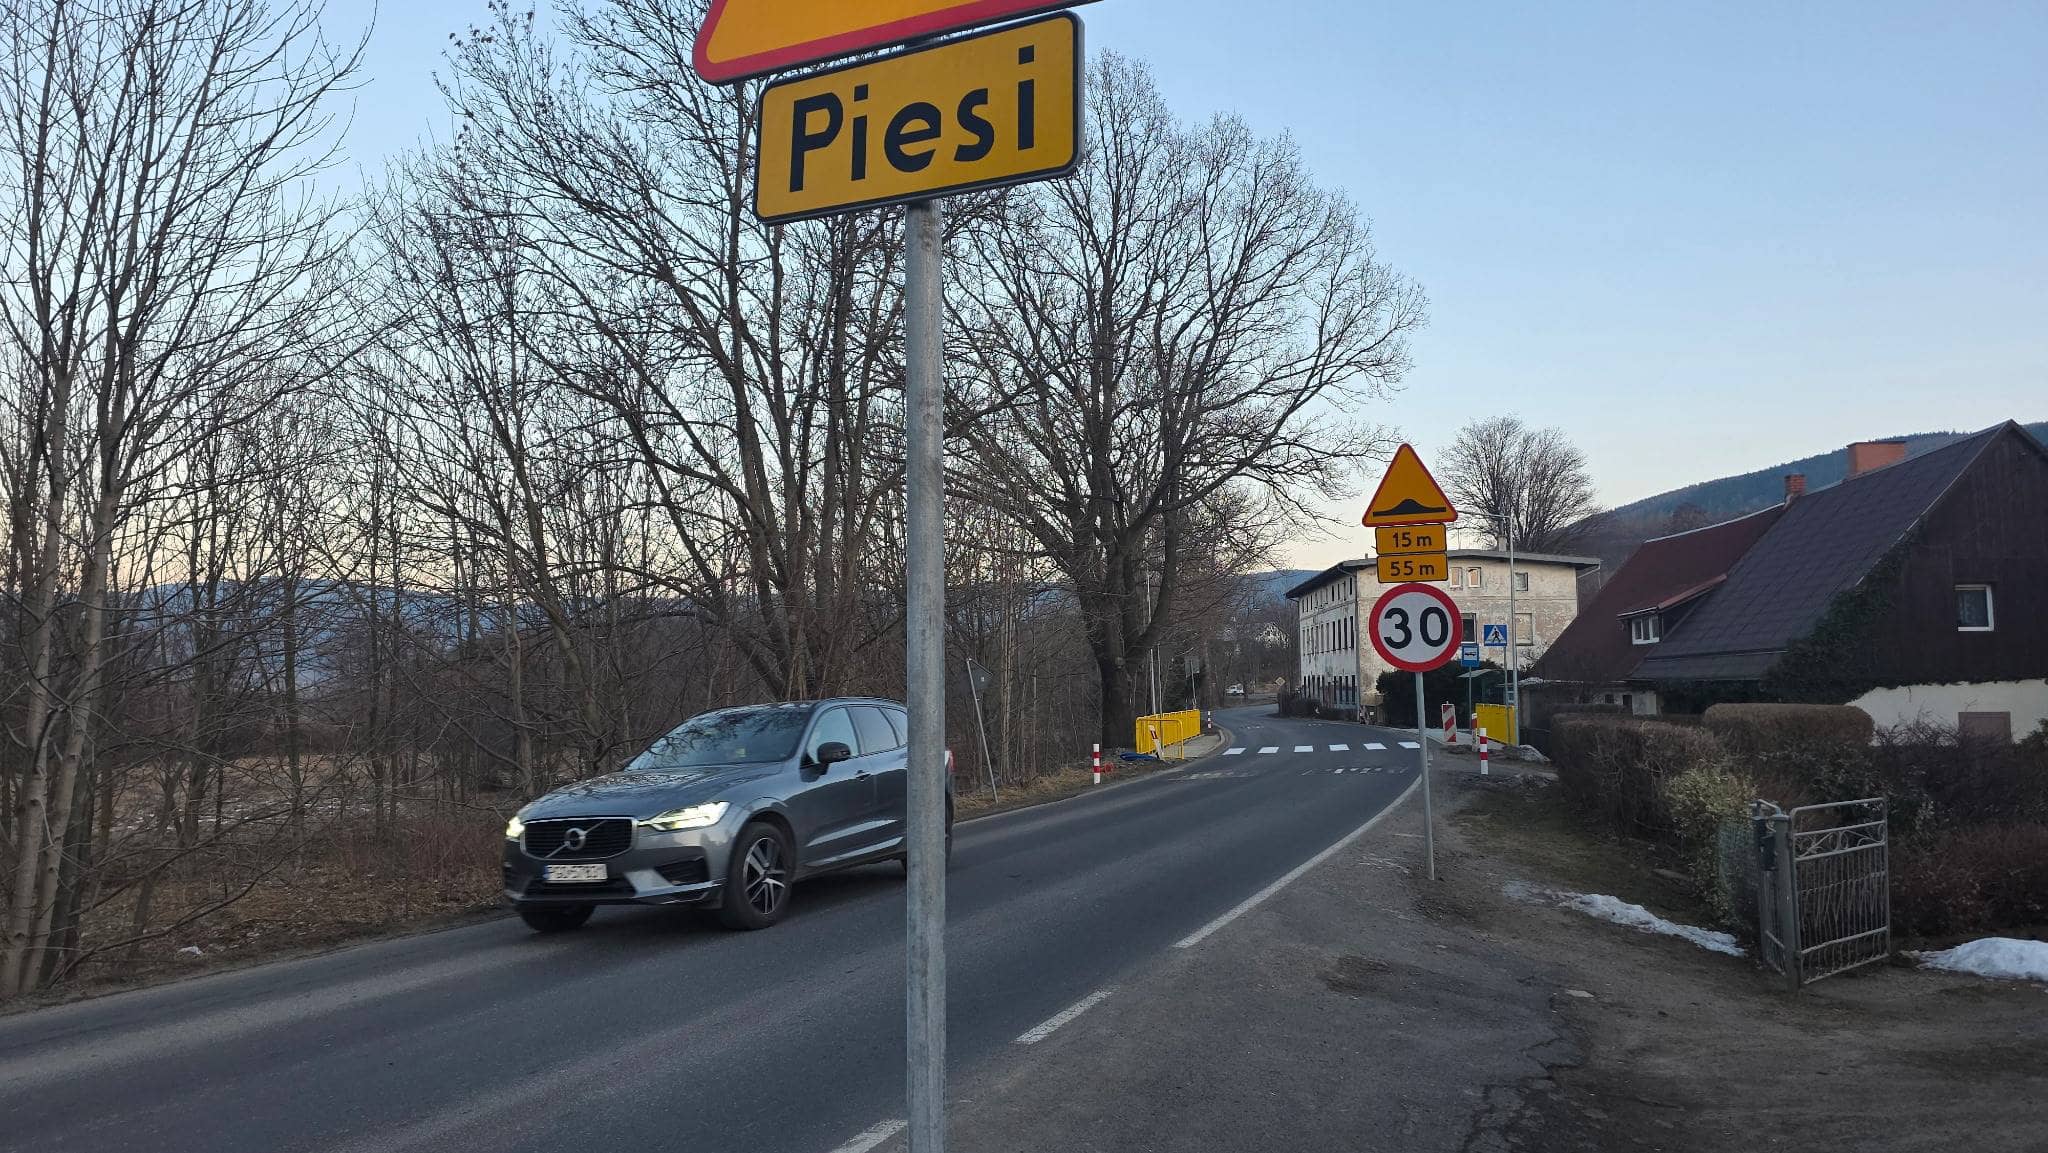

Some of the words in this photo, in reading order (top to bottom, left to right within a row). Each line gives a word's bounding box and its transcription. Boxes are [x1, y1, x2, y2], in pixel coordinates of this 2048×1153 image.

[789, 44, 1035, 193] Piesi
[1392, 532, 1412, 548] 15
[1416, 535, 1432, 547] m
[1390, 561, 1414, 577] 55
[1419, 563, 1435, 576] m
[1383, 606, 1449, 650] 30
